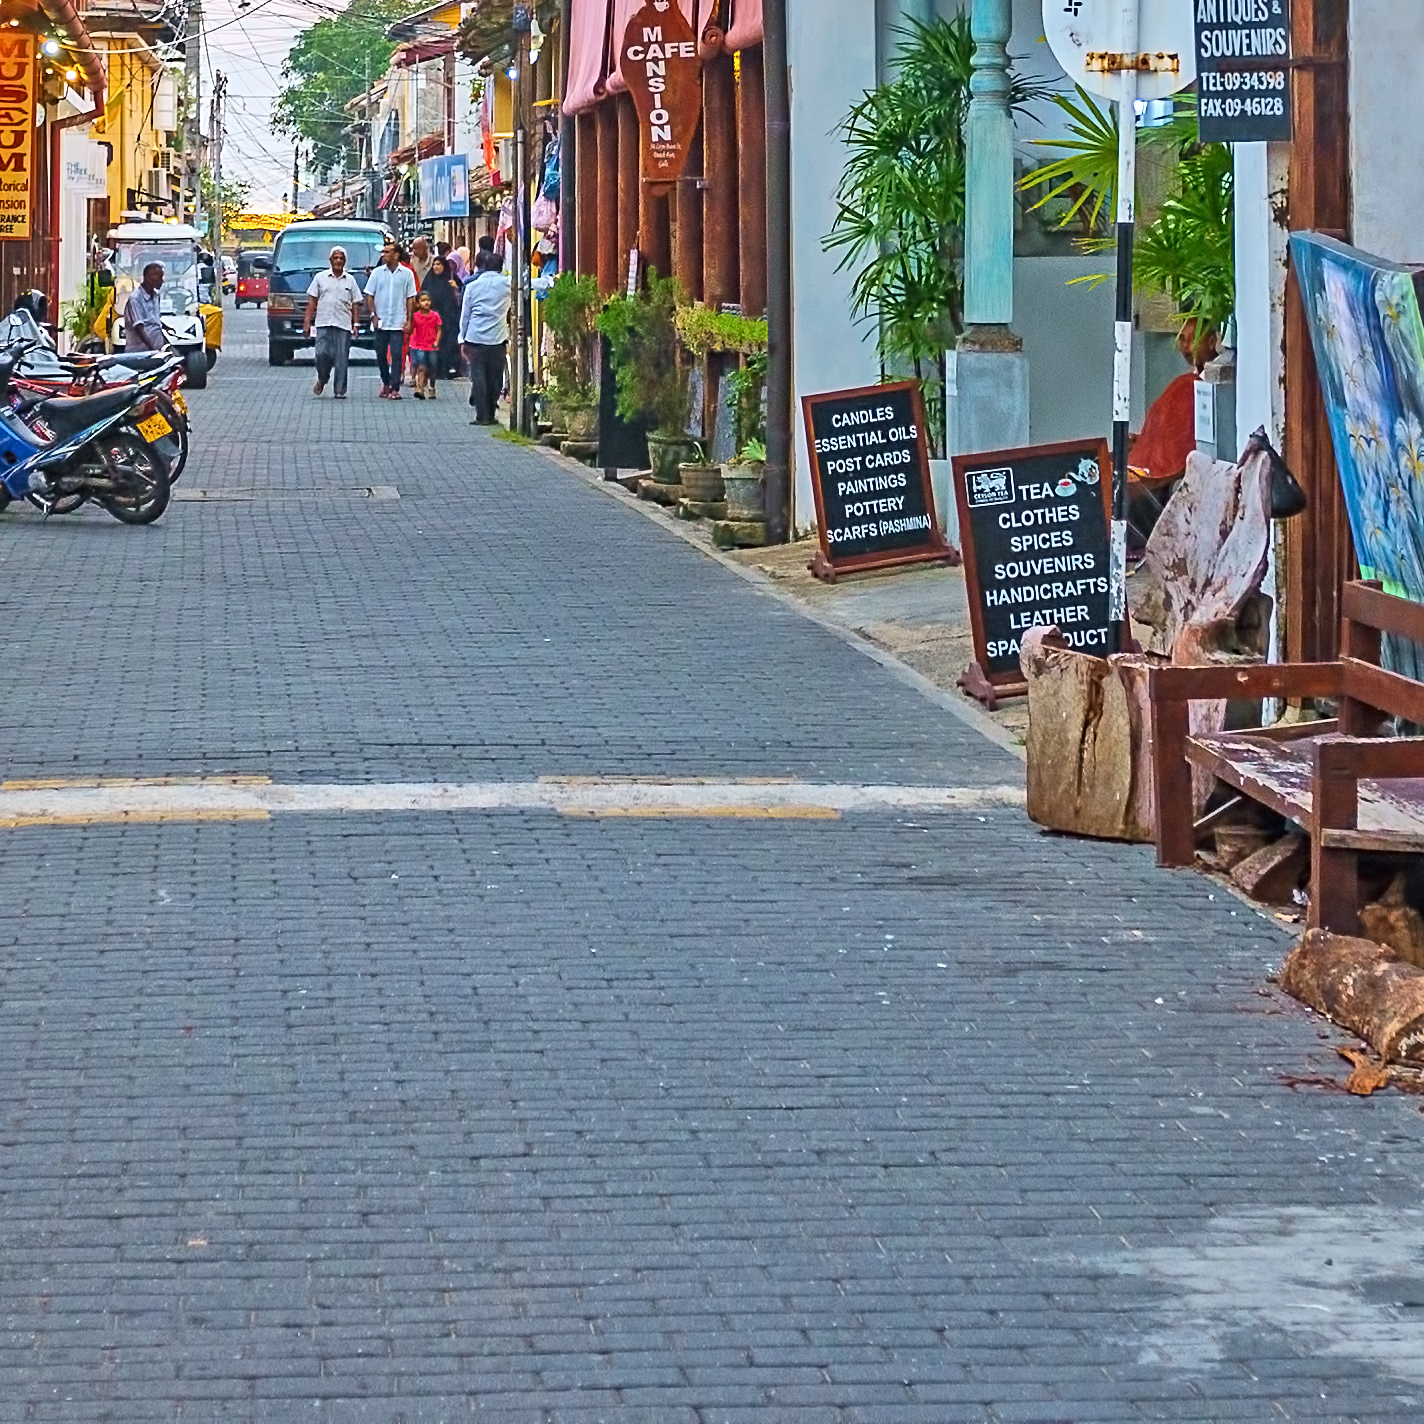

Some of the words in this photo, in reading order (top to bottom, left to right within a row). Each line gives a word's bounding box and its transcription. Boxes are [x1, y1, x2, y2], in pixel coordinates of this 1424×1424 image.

[1271, 0, 1282, 14] &
[627, 42, 695, 61] CAFE
[1200, 28, 1286, 58] SOUVENIRS
[642, 26, 672, 143] MANSION
[832, 406, 894, 428] CANDLES
[815, 430, 887, 453] ESSENTIAL
[888, 425, 918, 442] OILS
[827, 457, 863, 475] POST
[865, 449, 911, 469] CARDS
[837, 473, 907, 496] PAINTINGS
[1018, 482, 1055, 501] TEA
[845, 496, 905, 518] POTTERY
[998, 504, 1080, 529] CLOTHES
[826, 522, 878, 543] SCARFS
[1010, 530, 1074, 553] SPICES
[994, 553, 1095, 580] SOUVENIRS
[985, 577, 1108, 607] HANDICRAFTS
[1009, 605, 1090, 629] LEATHER
